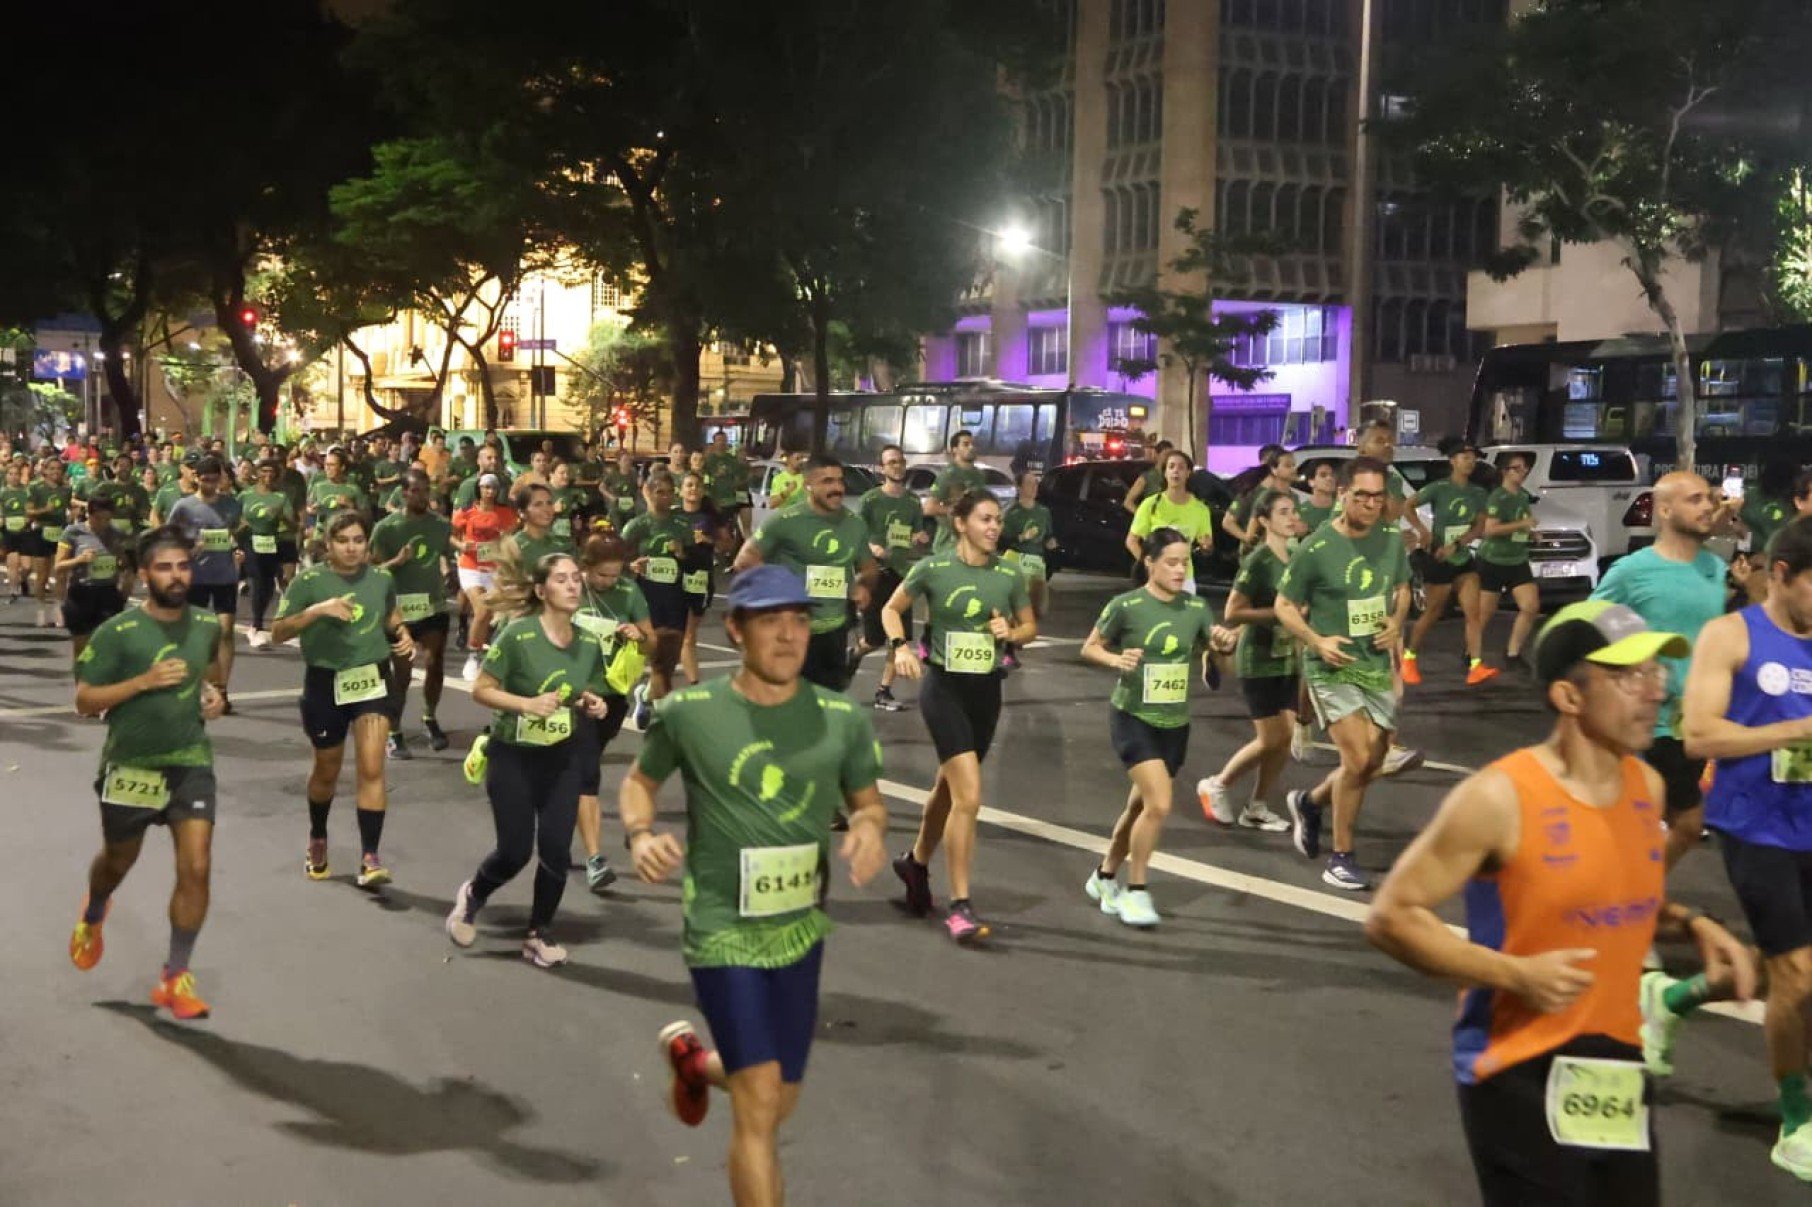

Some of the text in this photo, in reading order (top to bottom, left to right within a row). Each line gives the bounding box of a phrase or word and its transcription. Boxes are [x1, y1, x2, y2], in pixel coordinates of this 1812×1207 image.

[813, 578, 842, 589] 7457
[953, 647, 992, 661] 7059
[342, 679, 377, 692] 5031
[1152, 679, 1186, 690] 7462
[115, 779, 161, 797] 5721
[1562, 1093, 1635, 1118] 6964
